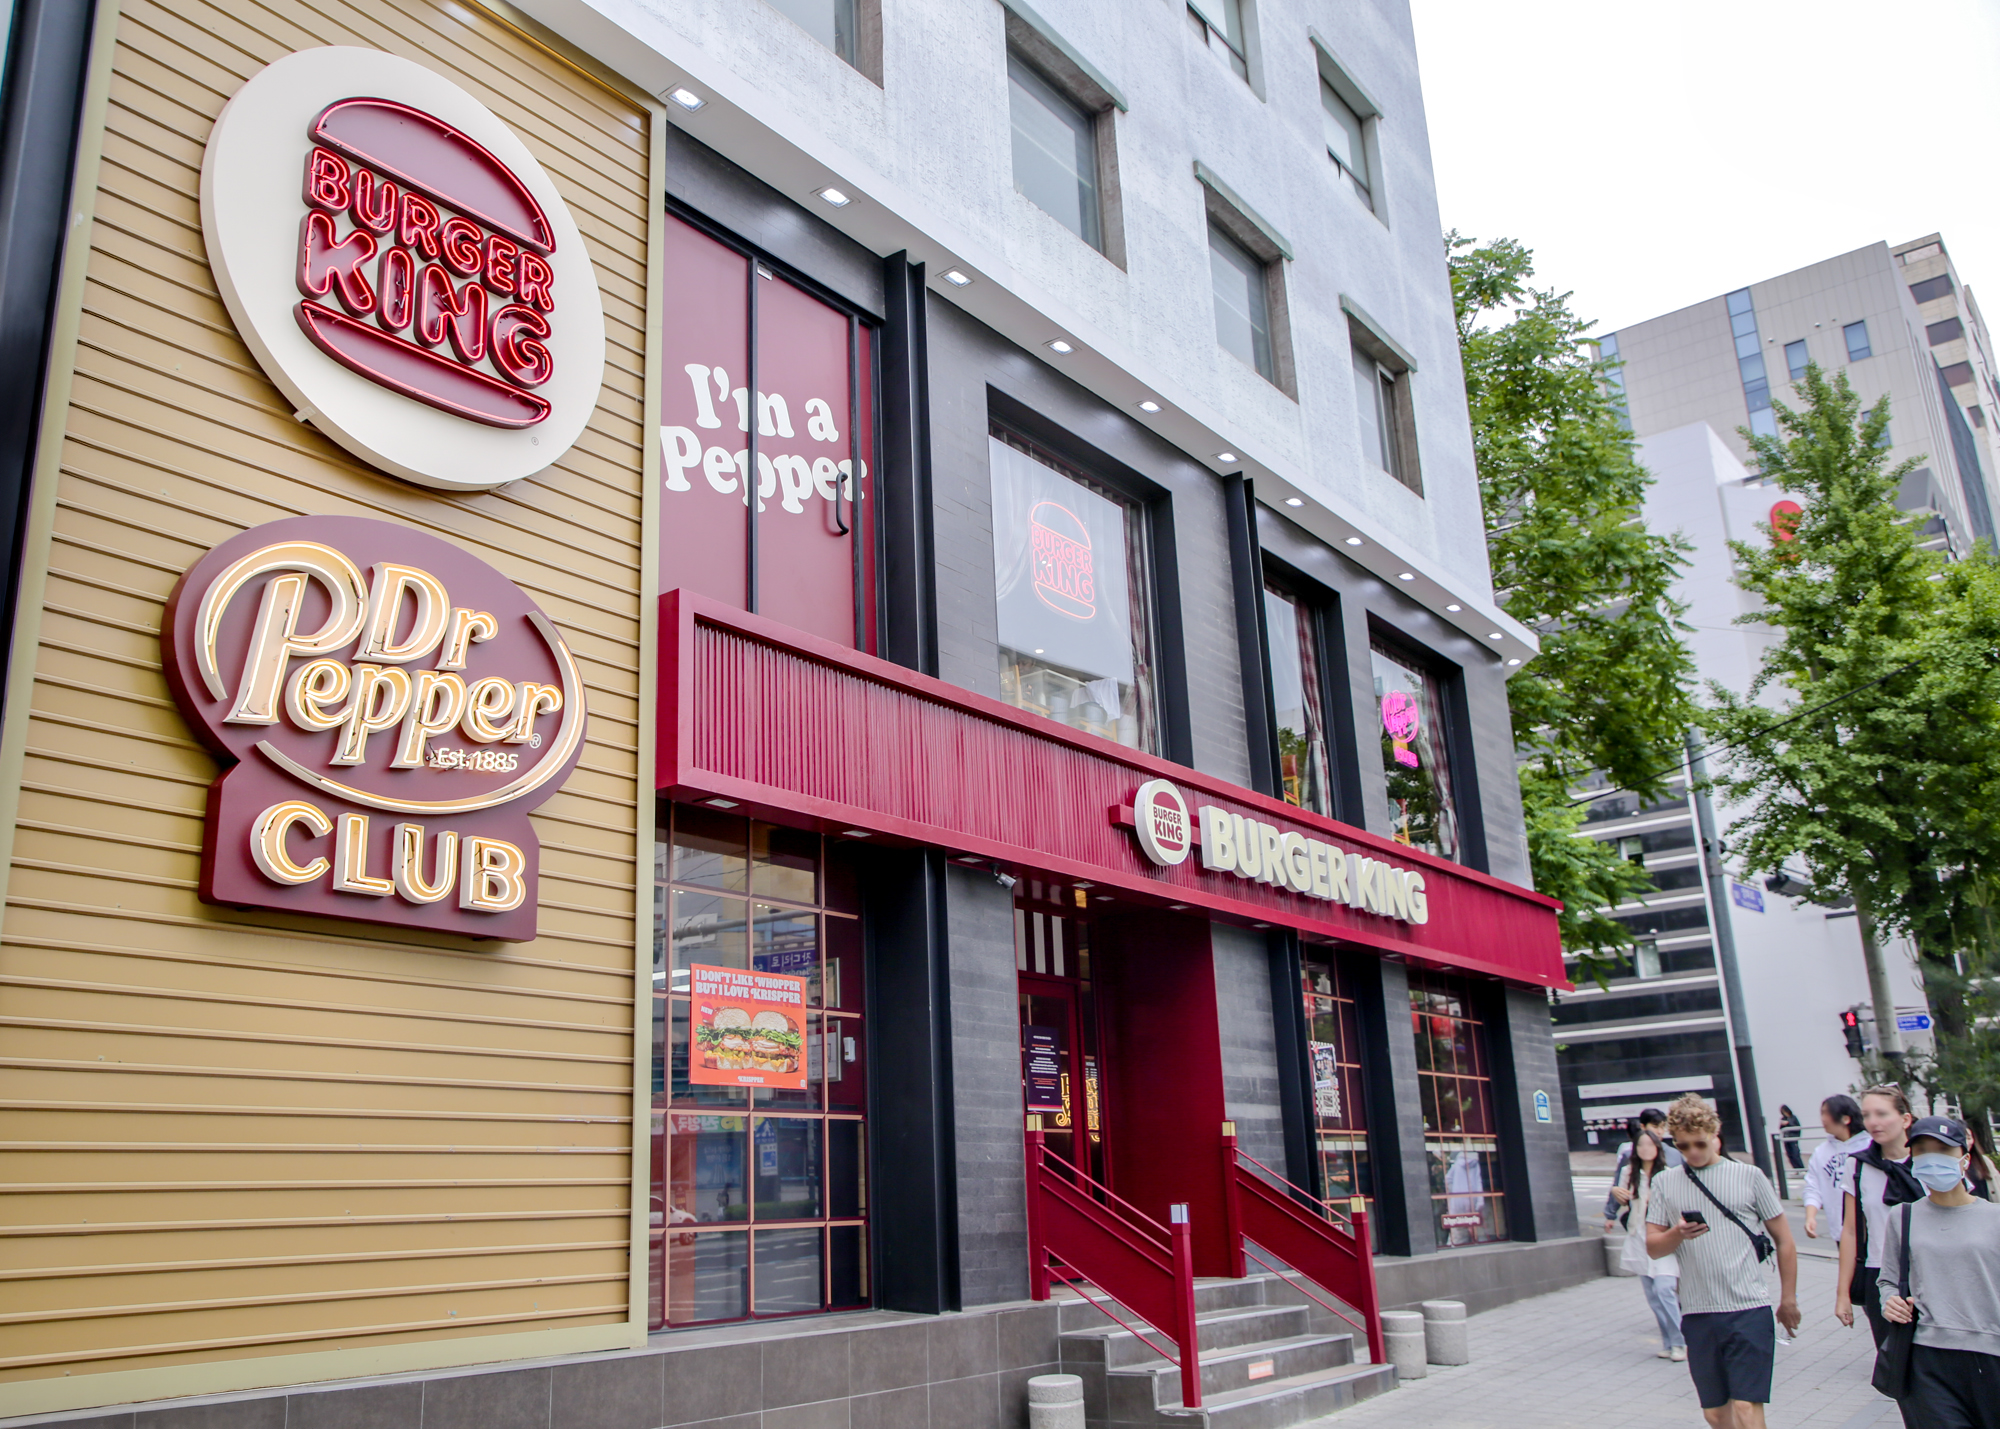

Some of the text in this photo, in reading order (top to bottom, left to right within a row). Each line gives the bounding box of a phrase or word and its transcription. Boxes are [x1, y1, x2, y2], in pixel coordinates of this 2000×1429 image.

[303, 146, 555, 314] BURGER
[297, 208, 554, 389] KING
[805, 398, 839, 442] a
[660, 426, 868, 514] Pepper
[1031, 525, 1093, 573] BURGER
[1033, 548, 1095, 602] KING
[353, 561, 498, 671] Dr
[195, 541, 563, 768] Pepper
[1153, 806, 1182, 825] BURGER
[1154, 819, 1183, 842] KING
[250, 800, 526, 912] CLUB
[1199, 805, 1428, 925] BURGER KING
[696, 969, 699, 980] I
[701, 970, 731, 984] DON'T
[732, 974, 753, 986] LIKE
[755, 976, 801, 991] WHOPPER
[696, 981, 801, 1004] BUT I LOVE KRISPPER
[701, 1005, 713, 1015] NEW
